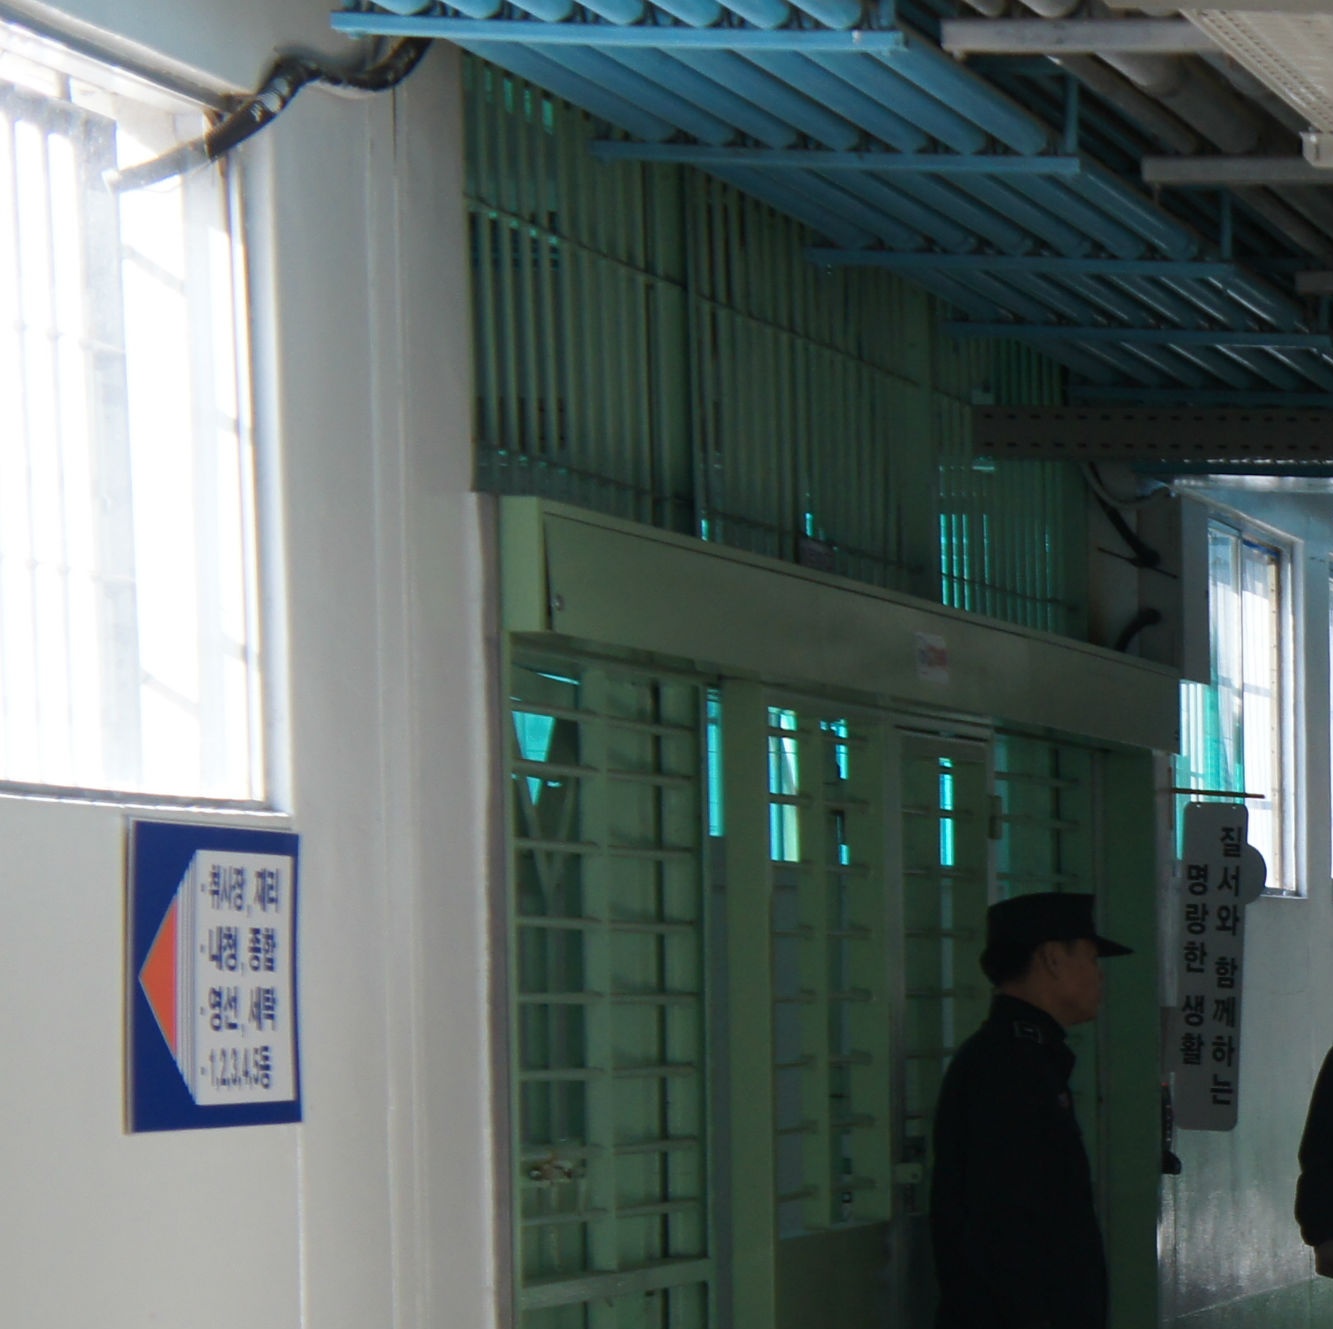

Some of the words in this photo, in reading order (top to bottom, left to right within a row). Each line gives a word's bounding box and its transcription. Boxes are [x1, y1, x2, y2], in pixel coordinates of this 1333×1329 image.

[1184, 864, 1208, 973] 명랑한
[1180, 995, 1205, 1066] 생활
[1210, 957, 1239, 1106] 함께하는
